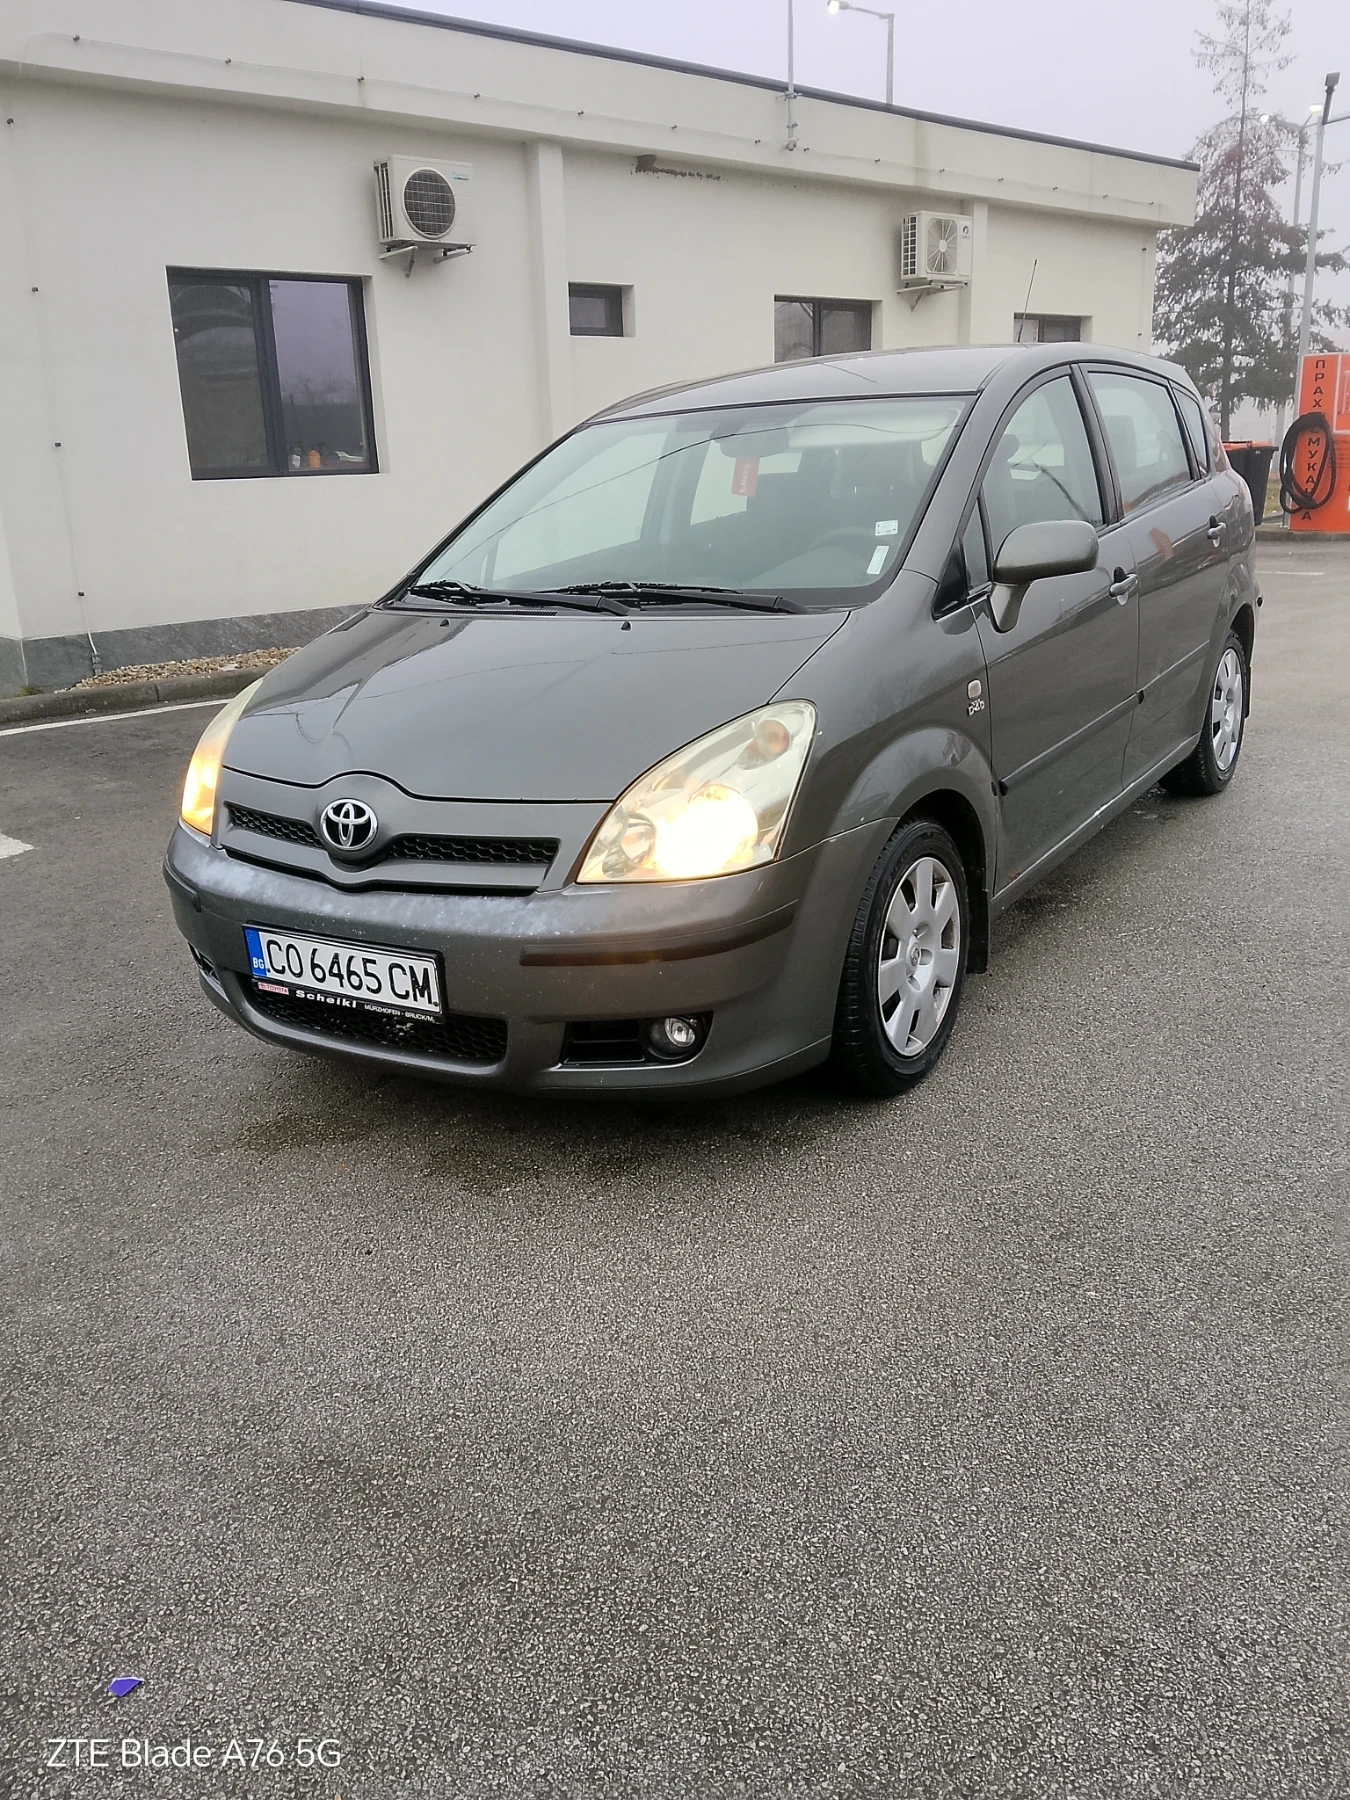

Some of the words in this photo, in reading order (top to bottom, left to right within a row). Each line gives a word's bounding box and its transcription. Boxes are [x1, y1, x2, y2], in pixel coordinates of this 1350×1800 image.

[252, 957, 264, 970] BG
[266, 940, 304, 978] CO
[310, 948, 382, 994] 6465
[388, 963, 432, 1005] CM
[267, 985, 288, 993] TOYOTA
[295, 990, 357, 1008] Scheikl
